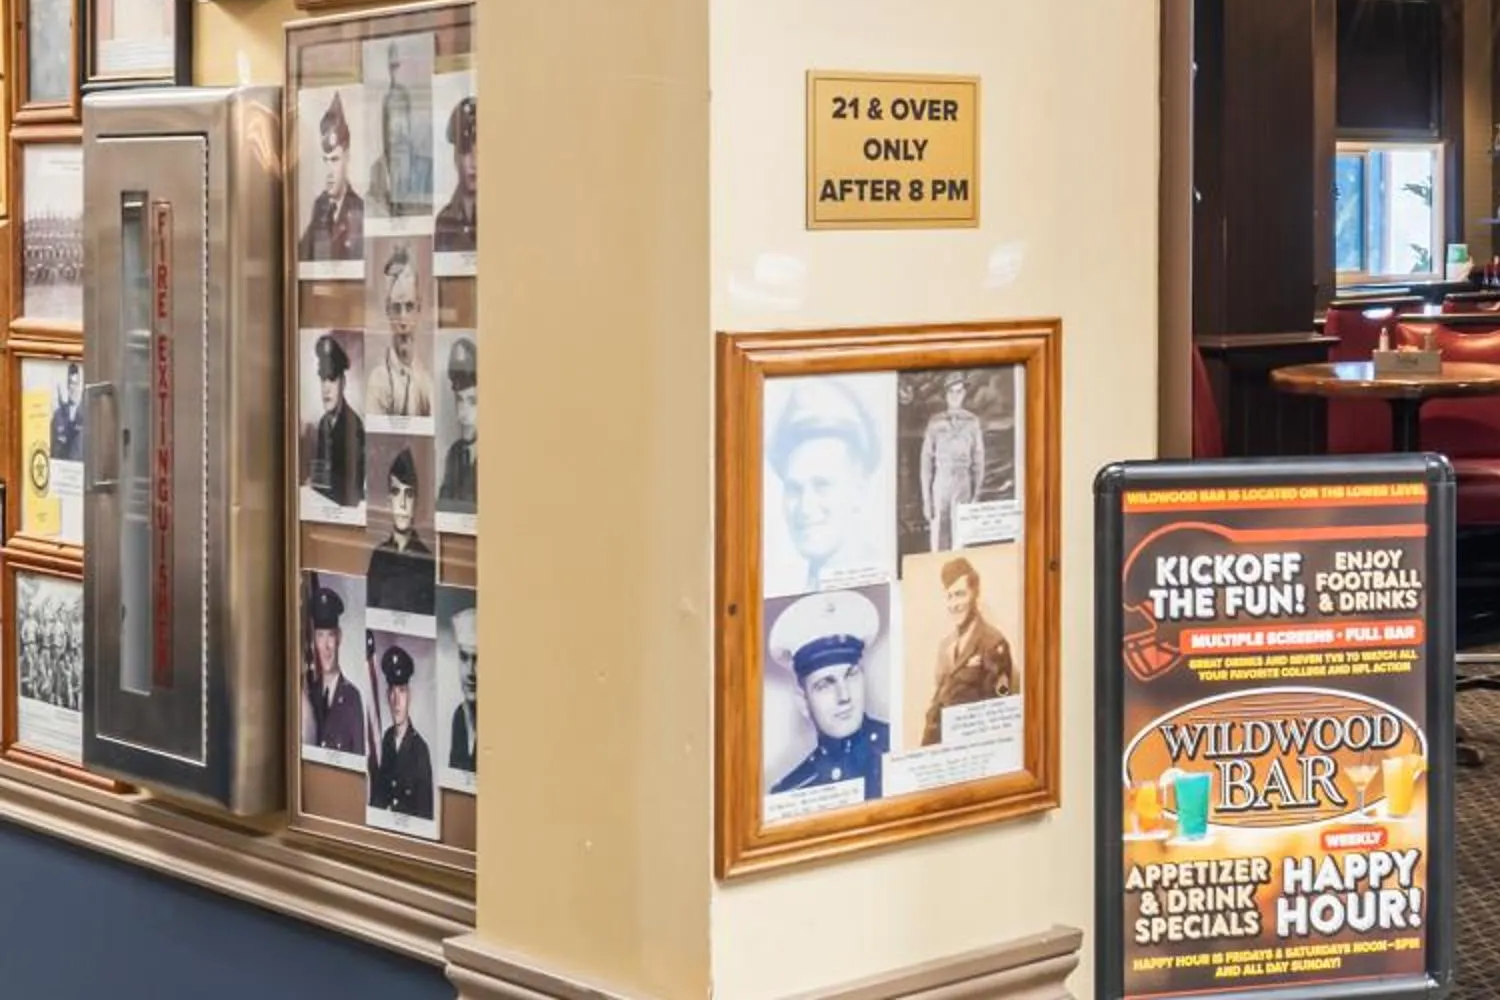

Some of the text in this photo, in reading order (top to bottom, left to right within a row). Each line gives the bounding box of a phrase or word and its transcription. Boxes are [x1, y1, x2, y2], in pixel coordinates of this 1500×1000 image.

[832, 97, 959, 121] 21 & OVER
[863, 138, 928, 161] ONLY
[819, 179, 969, 202] AFTER 8 PM
[157, 211, 168, 318] FIRE
[1155, 552, 1302, 586] KICKOFF
[1335, 549, 1403, 571] ENJOY
[1315, 569, 1422, 592] FOOTBALL
[1149, 583, 1305, 619] THE FUN!
[1319, 590, 1418, 612] & DRINKS
[1191, 625, 1416, 648] MULTIPLE SCREENS FULL BAR
[1199, 669, 1228, 680] YOUR
[1160, 713, 1400, 759] WILDWOOD
[1215, 755, 1346, 812] BAR
[1325, 831, 1382, 848] WEEKLY
[1125, 856, 1270, 891] APPETIZER
[1283, 850, 1421, 894] HAPPY
[1139, 886, 1256, 915] & DRINK
[1276, 888, 1423, 937] HOUR!
[1135, 911, 1260, 942] SPECIALS
[1133, 956, 1175, 972] HAPPY
[1176, 953, 1210, 968] HOUR
[1215, 957, 1341, 978] AND ALL DAY SUNDAY!
